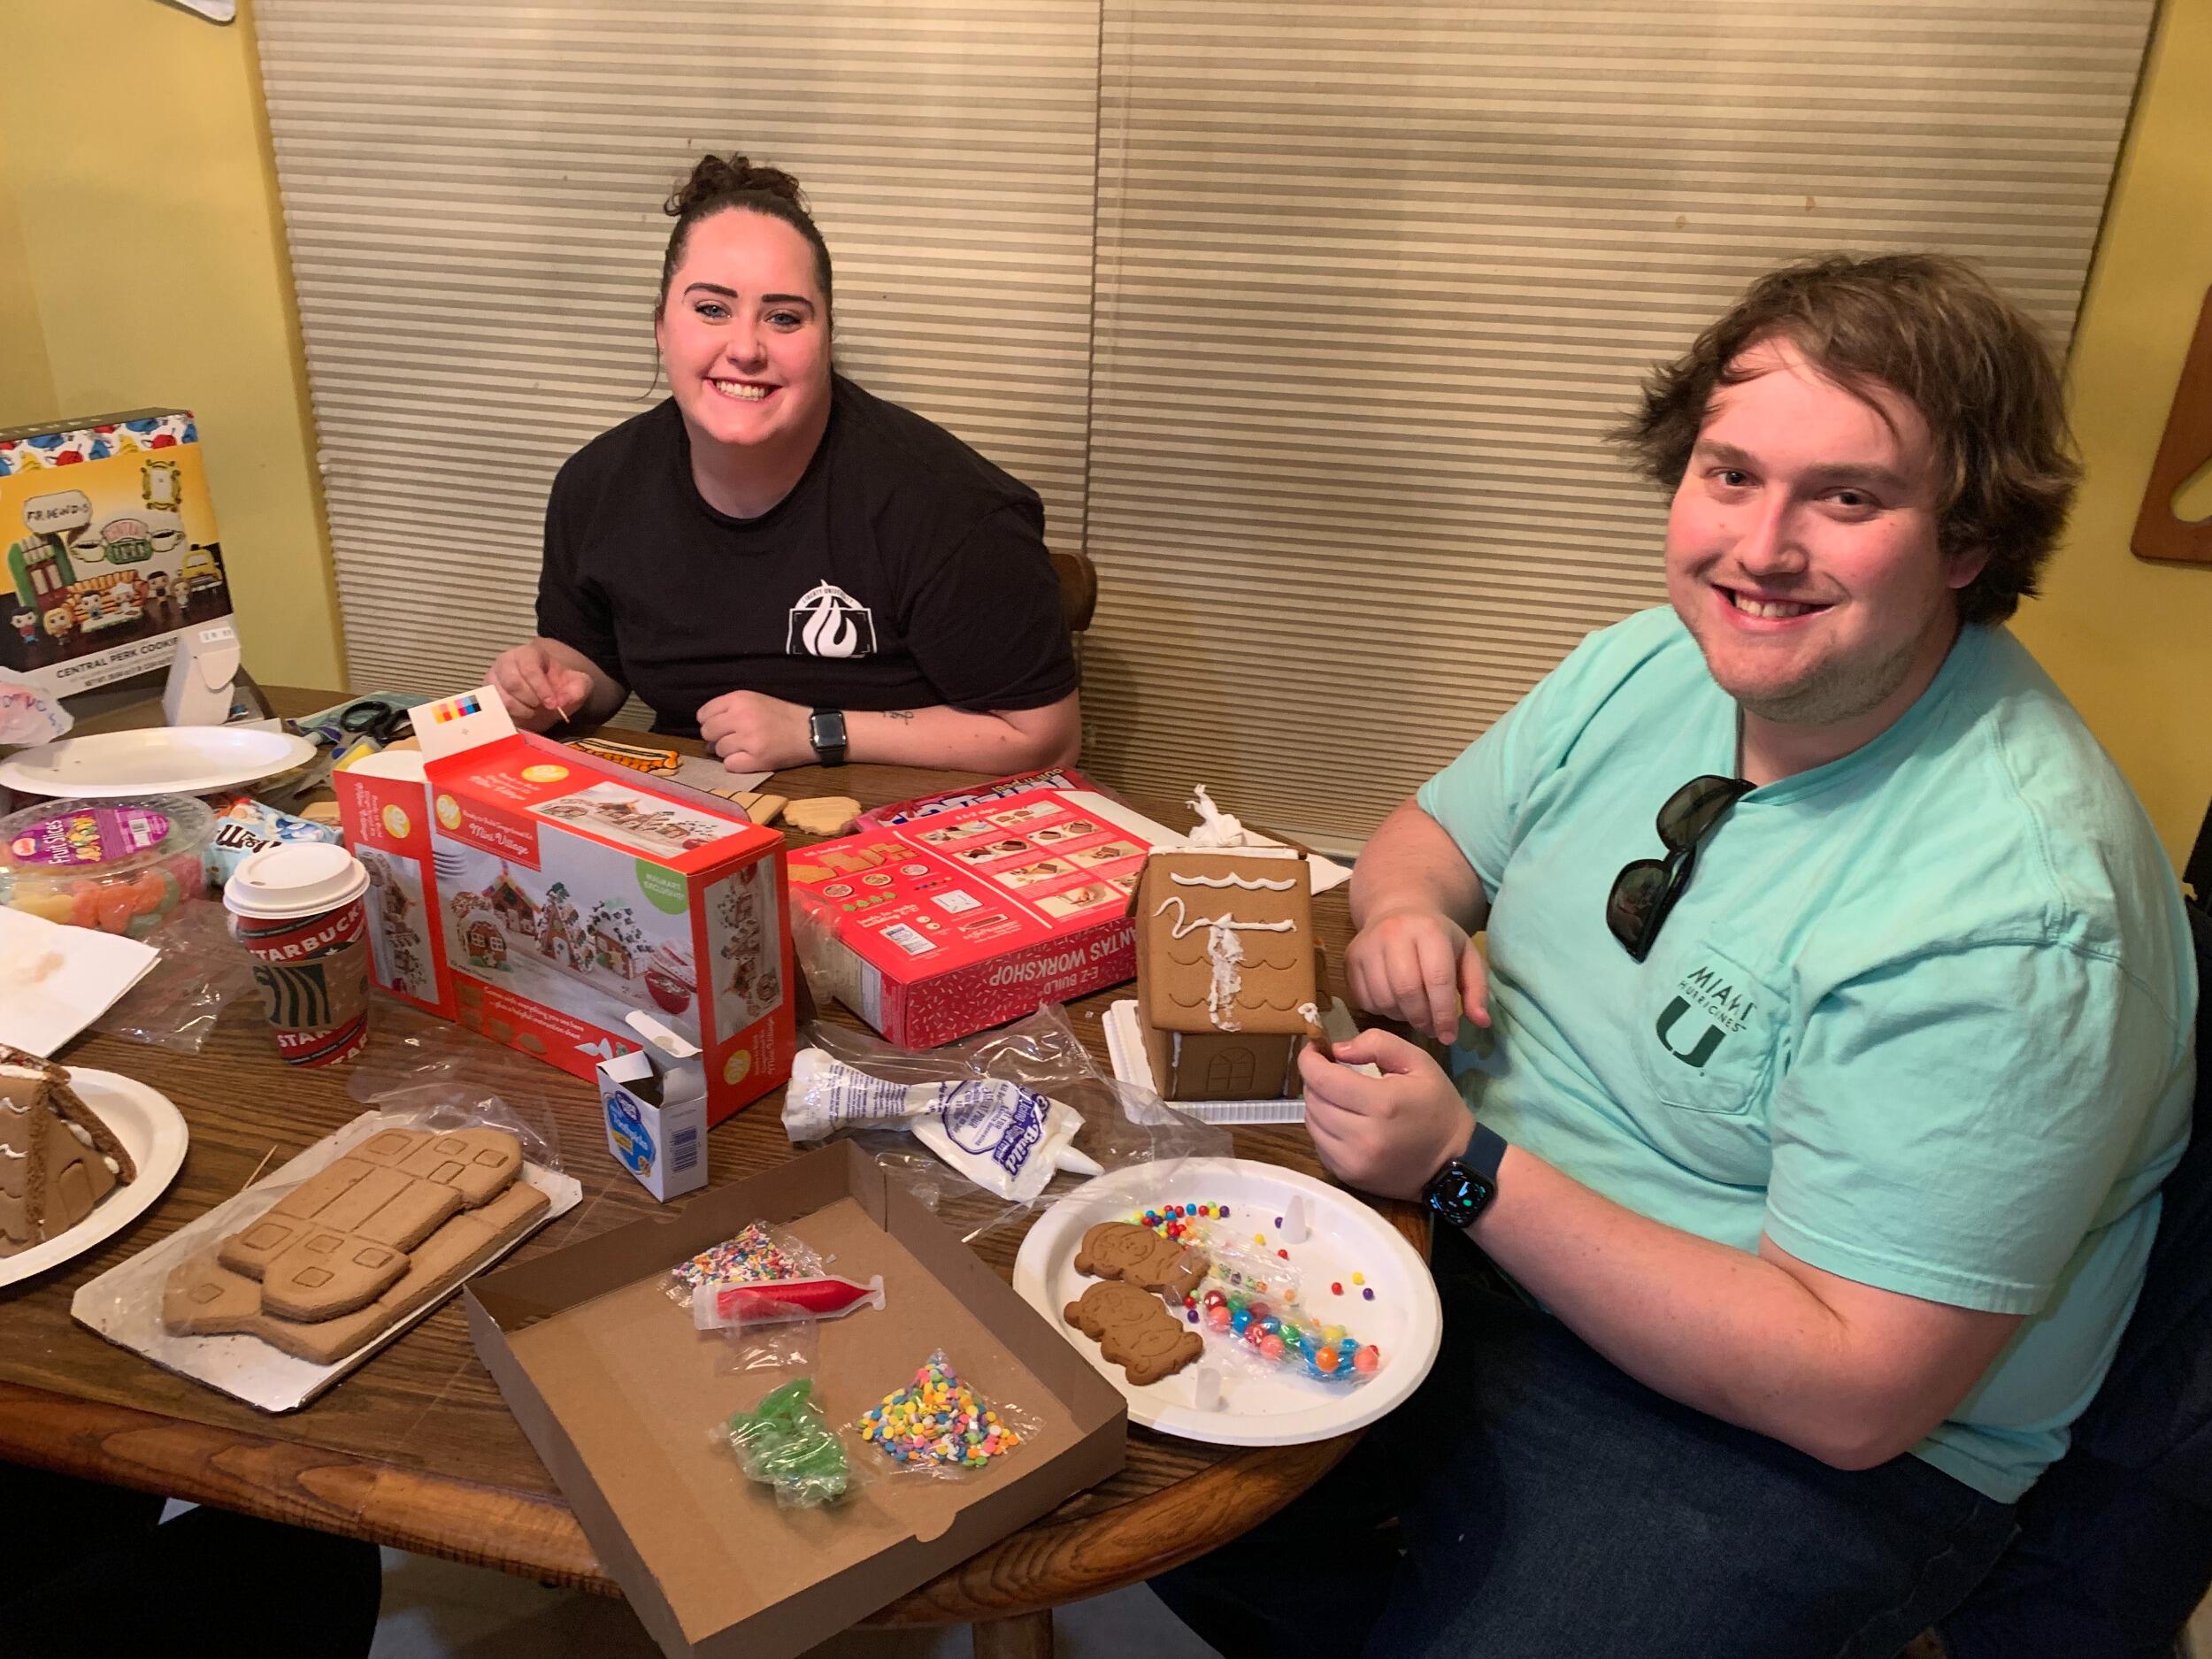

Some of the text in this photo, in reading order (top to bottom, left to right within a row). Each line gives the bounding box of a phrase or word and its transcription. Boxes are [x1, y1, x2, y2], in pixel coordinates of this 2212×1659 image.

[57, 657, 107, 679] CENTRAL
[111, 649, 138, 662] PERK
[42, 820, 71, 864] Fruit Slices
[250, 900, 363, 963] TARBUCK
[987, 926, 1139, 990] ANTA'S WORKSHOP
[1041, 965, 1098, 995] E-Z BUILD
[1655, 995, 1726, 1068] U
